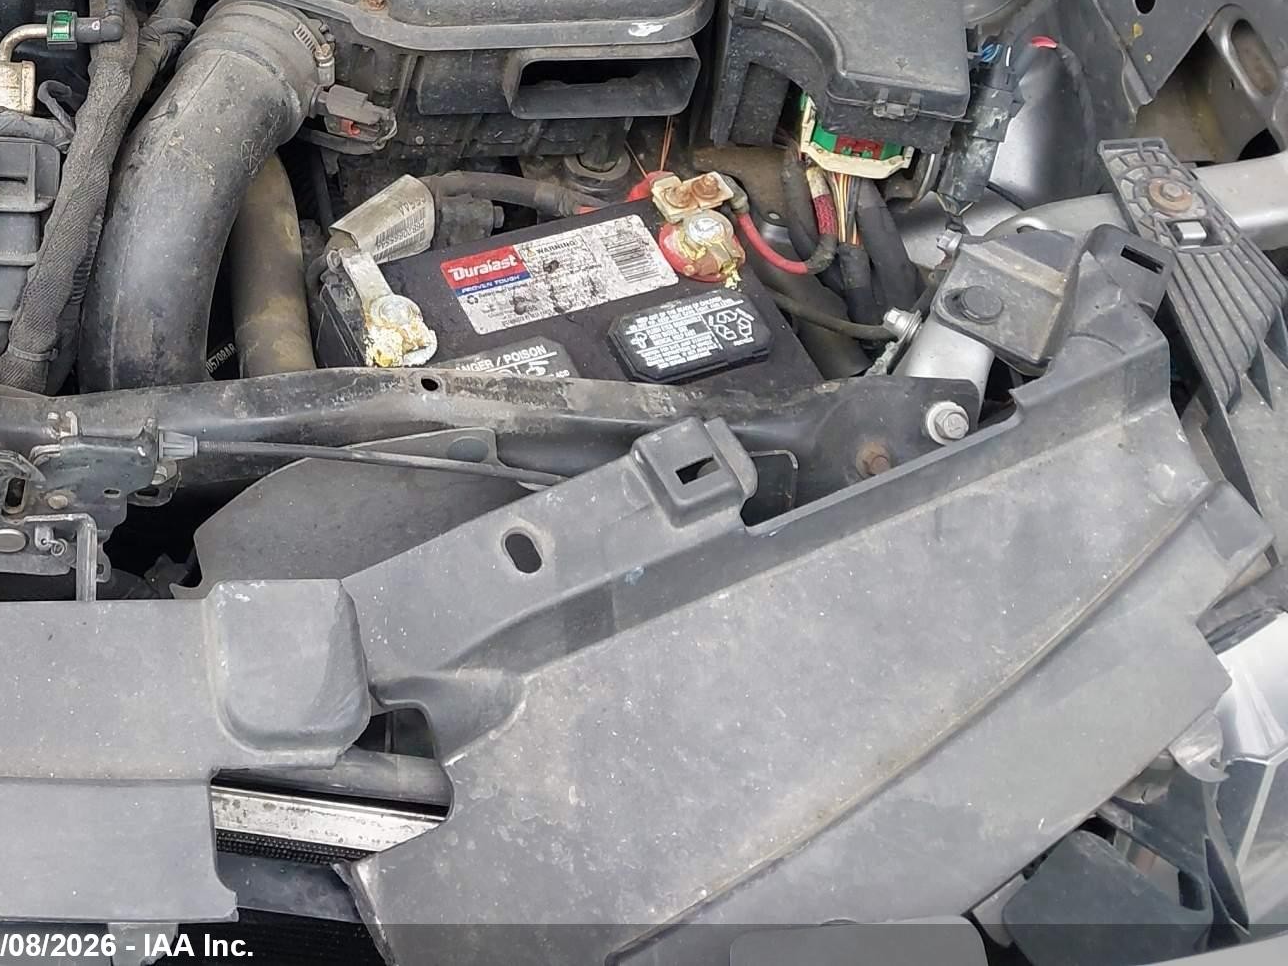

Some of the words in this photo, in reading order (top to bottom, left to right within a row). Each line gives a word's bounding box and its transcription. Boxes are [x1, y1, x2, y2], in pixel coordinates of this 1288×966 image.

[448, 254, 518, 282] Duralast
[461, 281, 493, 294] PROVEN
[494, 275, 520, 286] TOUGH
[503, 344, 547, 364] POISON
